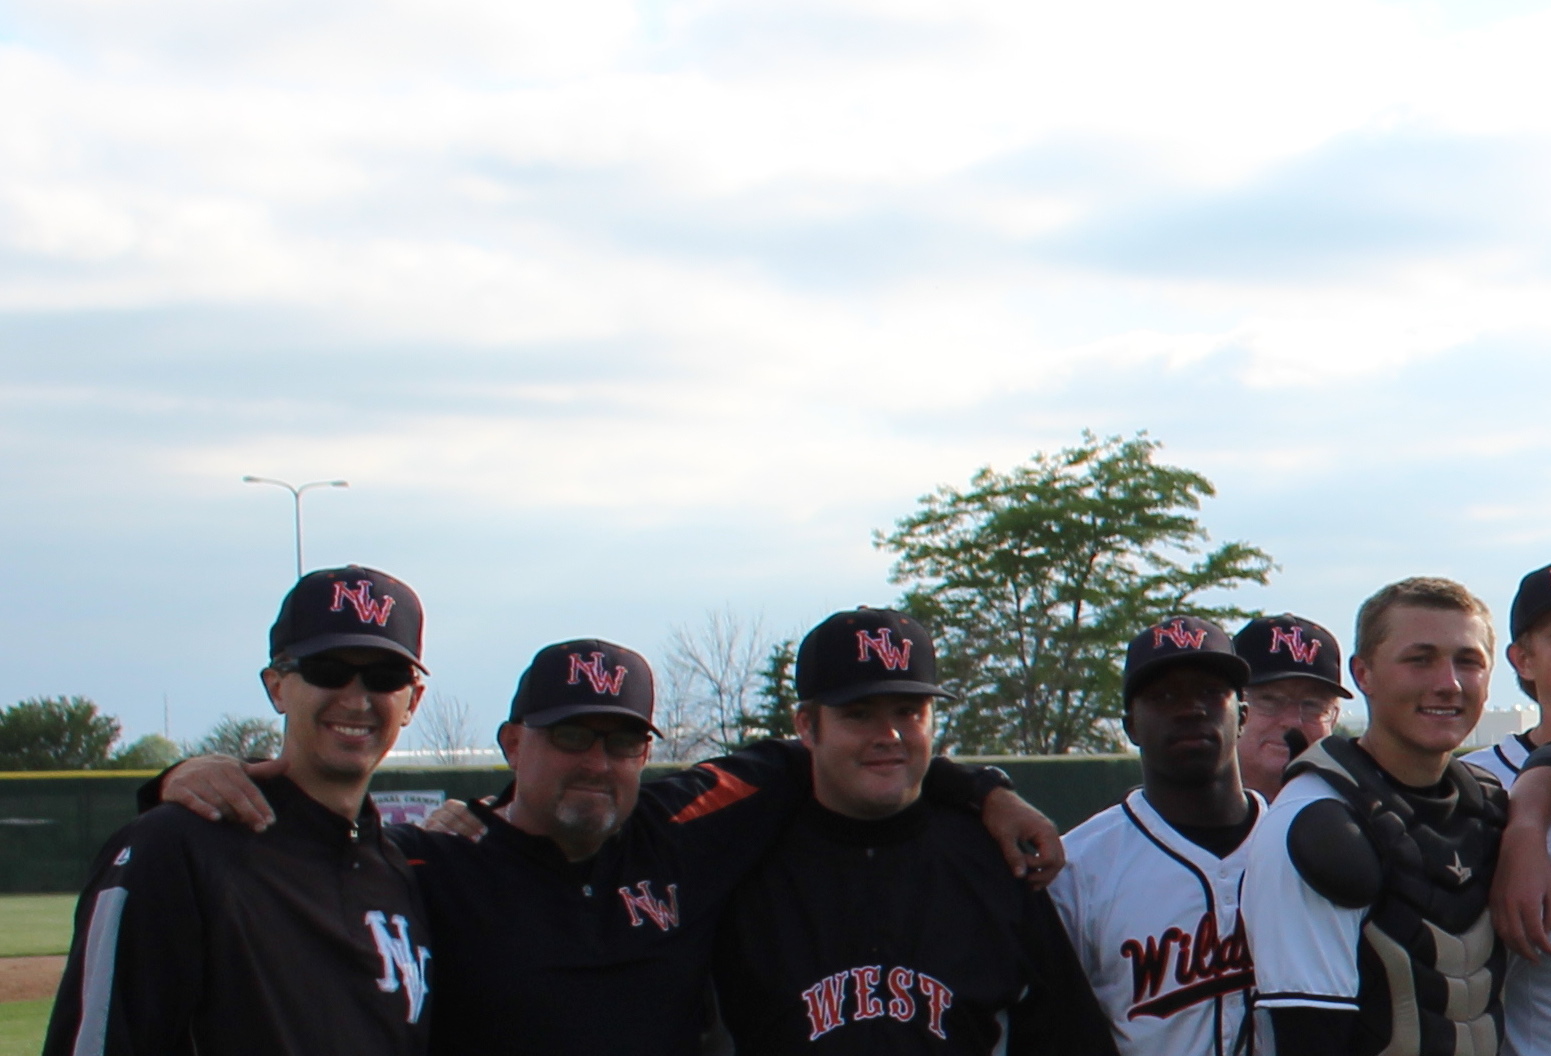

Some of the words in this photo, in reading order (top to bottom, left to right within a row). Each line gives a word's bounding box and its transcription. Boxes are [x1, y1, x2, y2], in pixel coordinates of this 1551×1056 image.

[331, 579, 396, 627] NW
[856, 628, 914, 671] NW
[1152, 620, 1207, 650] NW
[1269, 627, 1322, 666] NW
[568, 652, 628, 697] NW
[618, 880, 680, 931] NW
[801, 965, 954, 1042] WEST
